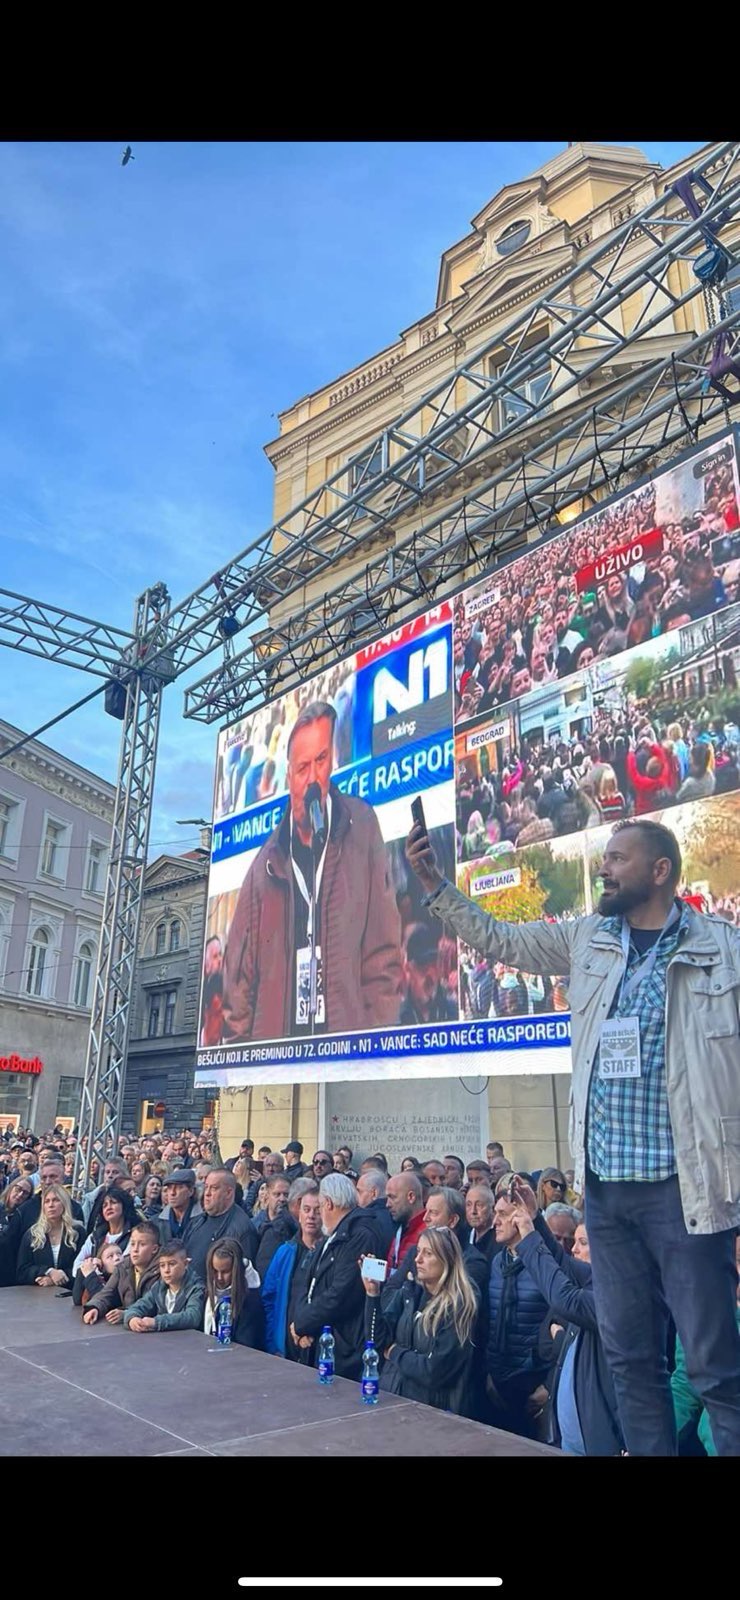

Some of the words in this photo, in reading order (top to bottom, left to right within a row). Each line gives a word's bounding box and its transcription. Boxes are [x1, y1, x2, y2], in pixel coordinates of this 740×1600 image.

[701, 459, 717, 472] Sign
[717, 454, 726, 462] in
[595, 544, 643, 580] UŽIVO
[373, 636, 449, 724] N1
[471, 726, 505, 747] BEOGRAD
[475, 874, 515, 892] LJUBLJANA
[197, 1050, 226, 1067] BEŠLIĆU
[226, 1051, 241, 1064] KOJI
[241, 1049, 250, 1063] JE
[250, 1045, 294, 1062] PREMINUO
[295, 1044, 302, 1058] U
[303, 1043, 316, 1057] 72.
[317, 1040, 351, 1057] GODINI
[358, 1038, 372, 1054] N1
[380, 1034, 421, 1051] VANCE:
[423, 1031, 448, 1048] SAD
[450, 1024, 484, 1046] NEĆE
[602, 1059, 636, 1074] STAFF
